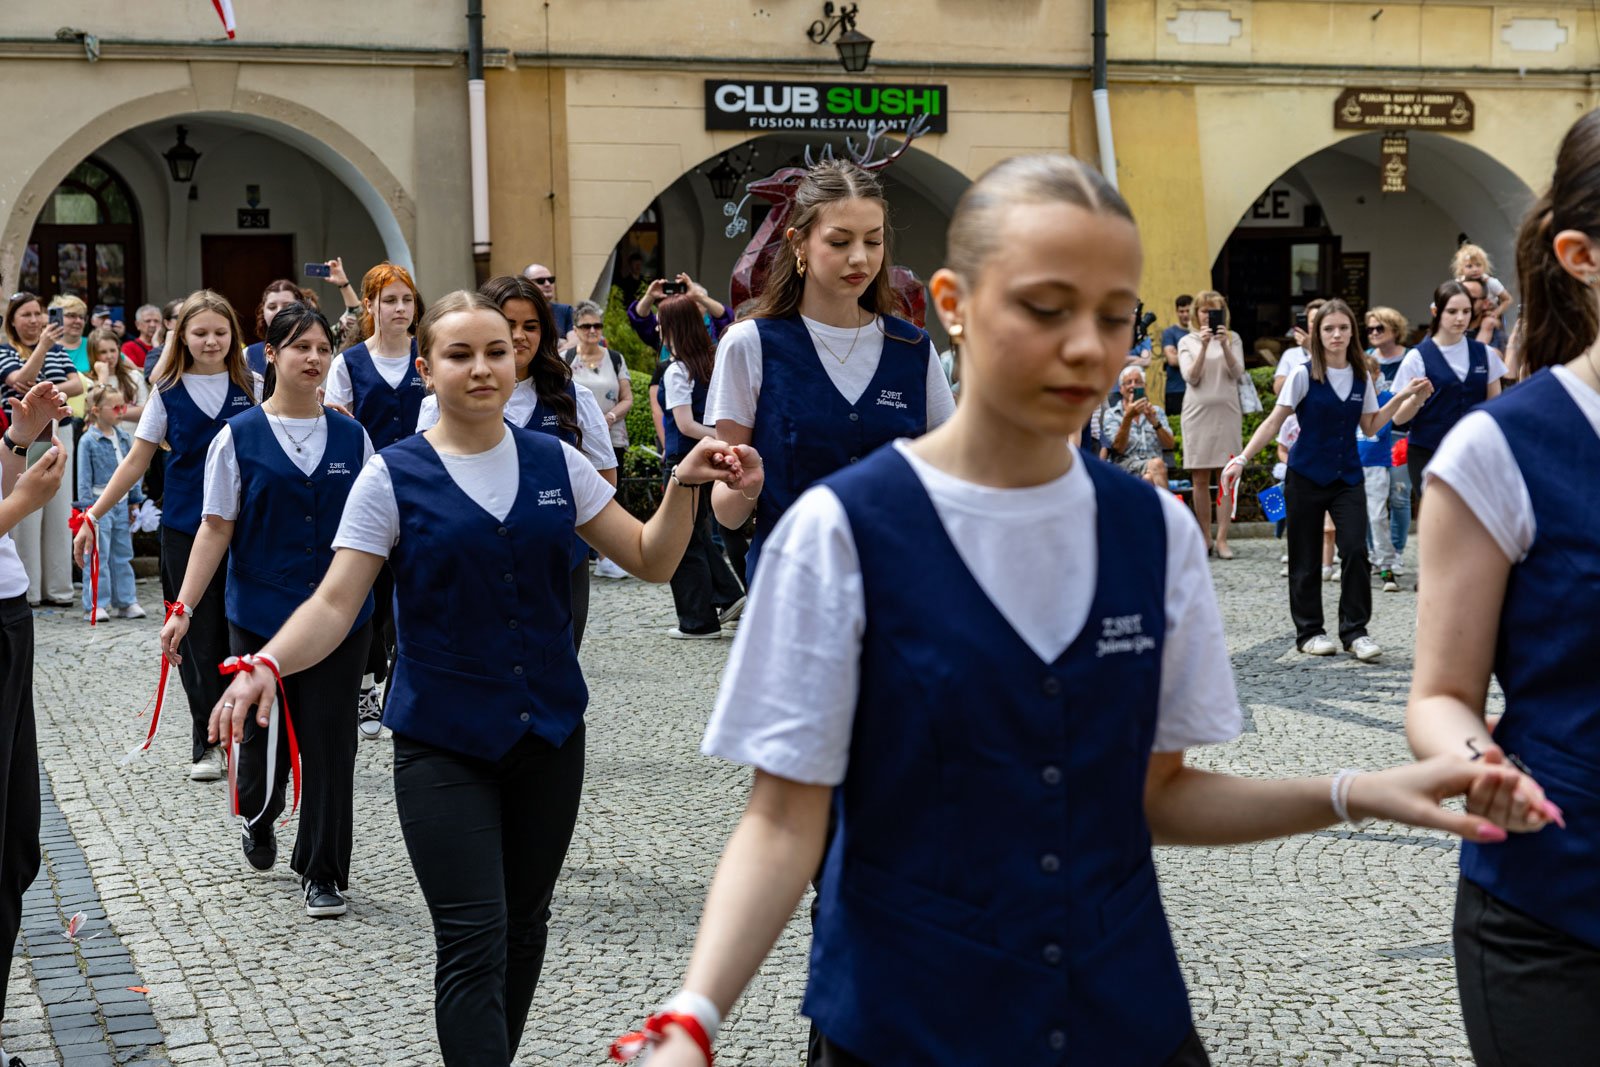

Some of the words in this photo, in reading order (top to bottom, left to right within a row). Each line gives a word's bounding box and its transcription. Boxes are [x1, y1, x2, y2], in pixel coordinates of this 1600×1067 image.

[714, 84, 819, 114] CLUB
[826, 87, 940, 115] SUSHI
[749, 117, 806, 128] FUSION
